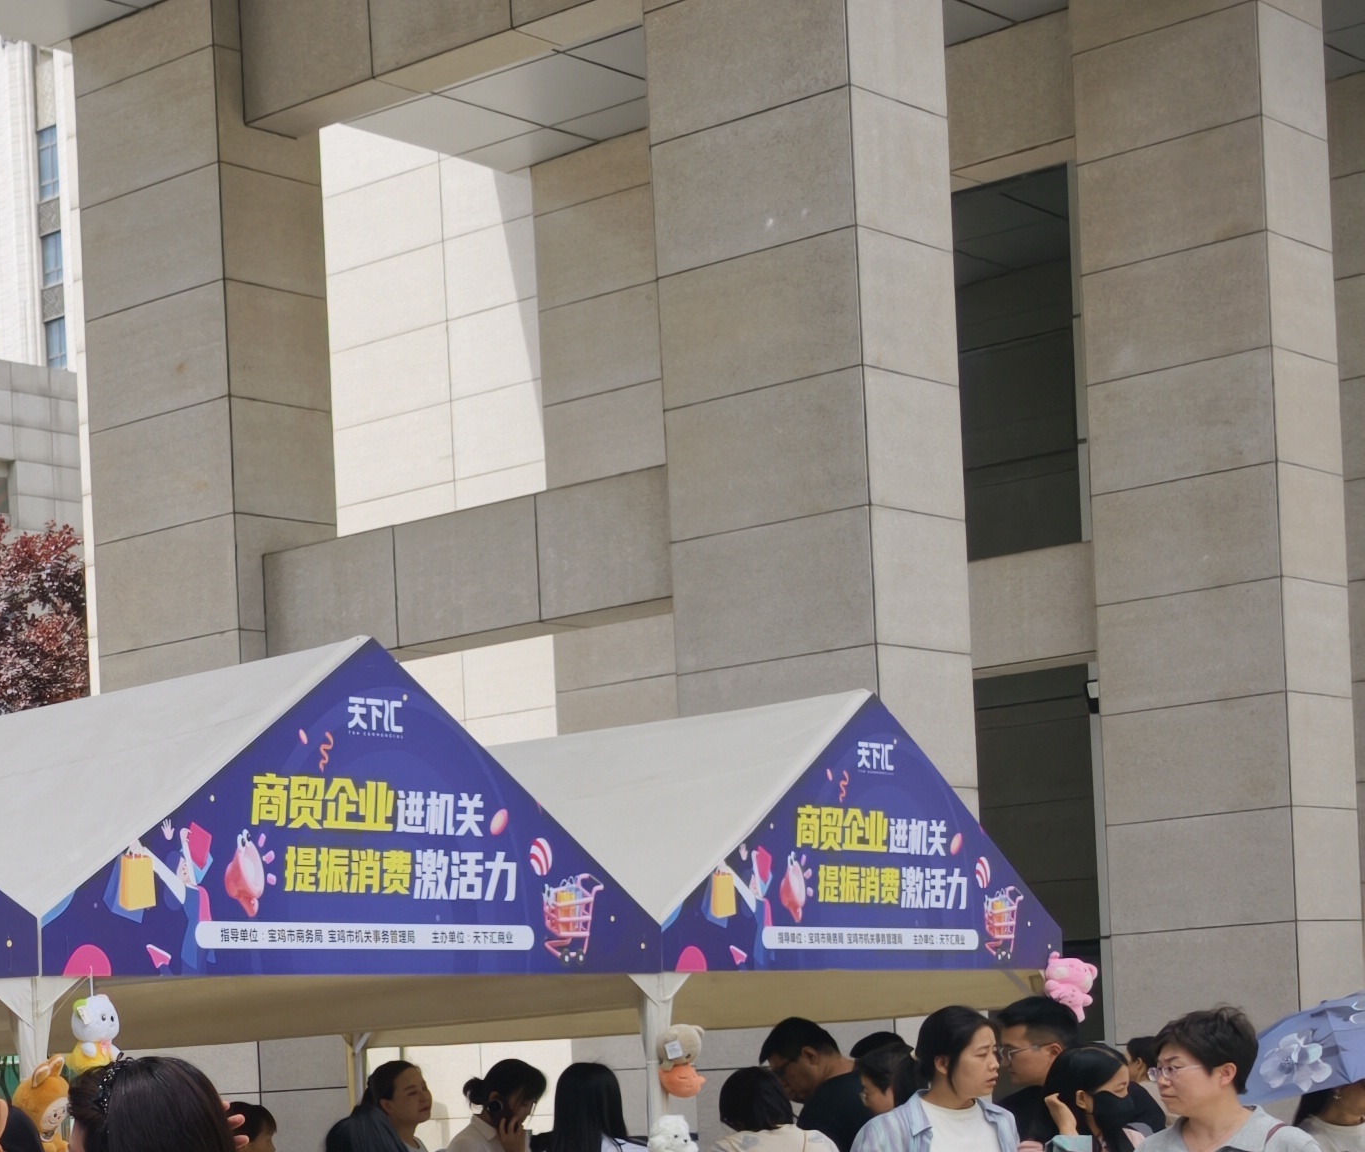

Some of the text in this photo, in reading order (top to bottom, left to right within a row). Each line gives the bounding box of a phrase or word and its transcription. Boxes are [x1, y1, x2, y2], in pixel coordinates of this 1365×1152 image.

[347, 696, 403, 733] 天下汇
[857, 741, 895, 771] 天下汇
[251, 773, 485, 838] 商贸企业进机关
[796, 804, 947, 857] 商贸企业进机关
[284, 846, 518, 902] 提振消费激活力
[817, 864, 968, 910] 提振消费激活力
[328, 928, 416, 945] 宝鸡市机关事务管理局
